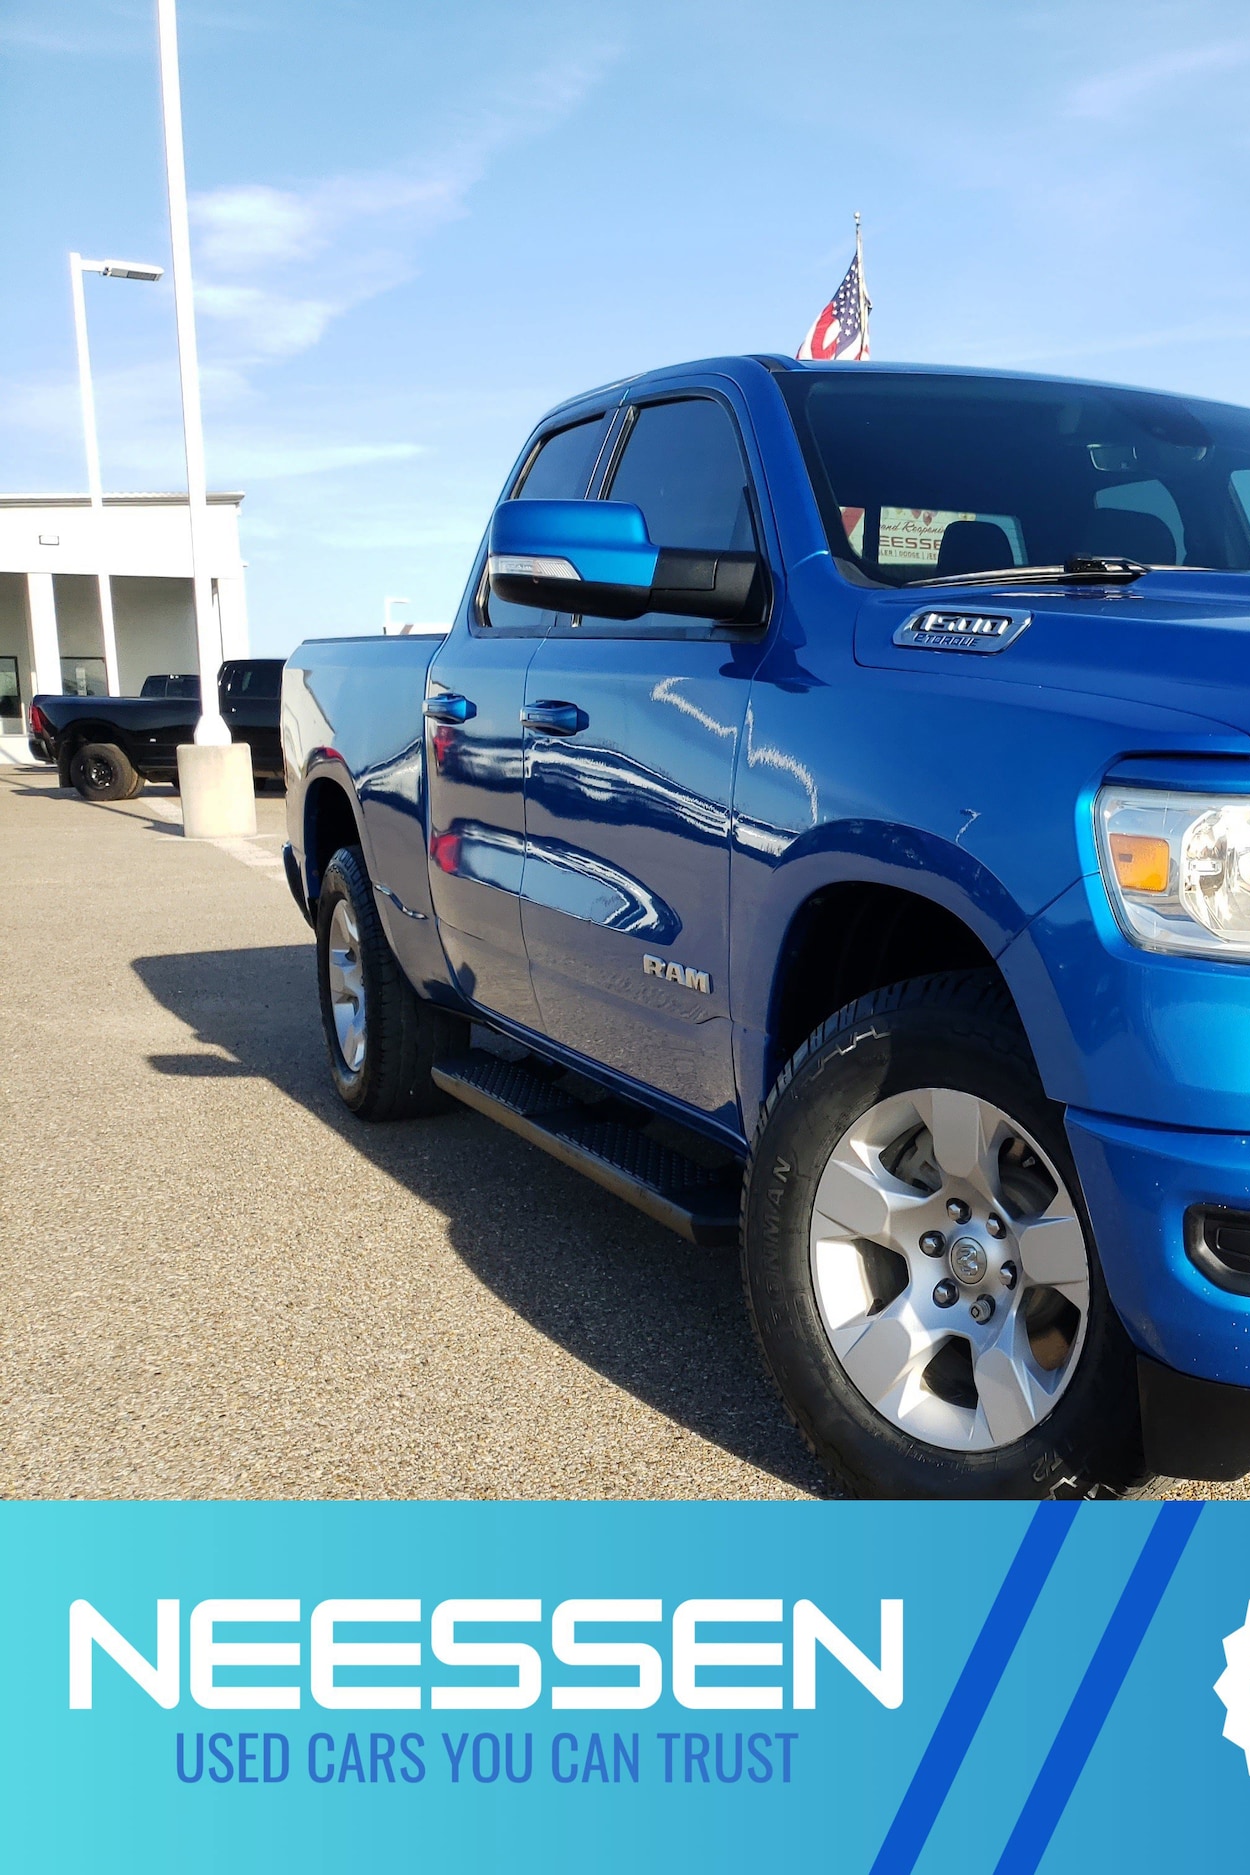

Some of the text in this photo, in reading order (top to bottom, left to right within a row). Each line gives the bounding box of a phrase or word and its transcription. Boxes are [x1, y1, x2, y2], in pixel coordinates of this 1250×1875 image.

[880, 536, 942, 551] EESSE
[919, 612, 1010, 636] 1500
[643, 953, 714, 994] RAM
